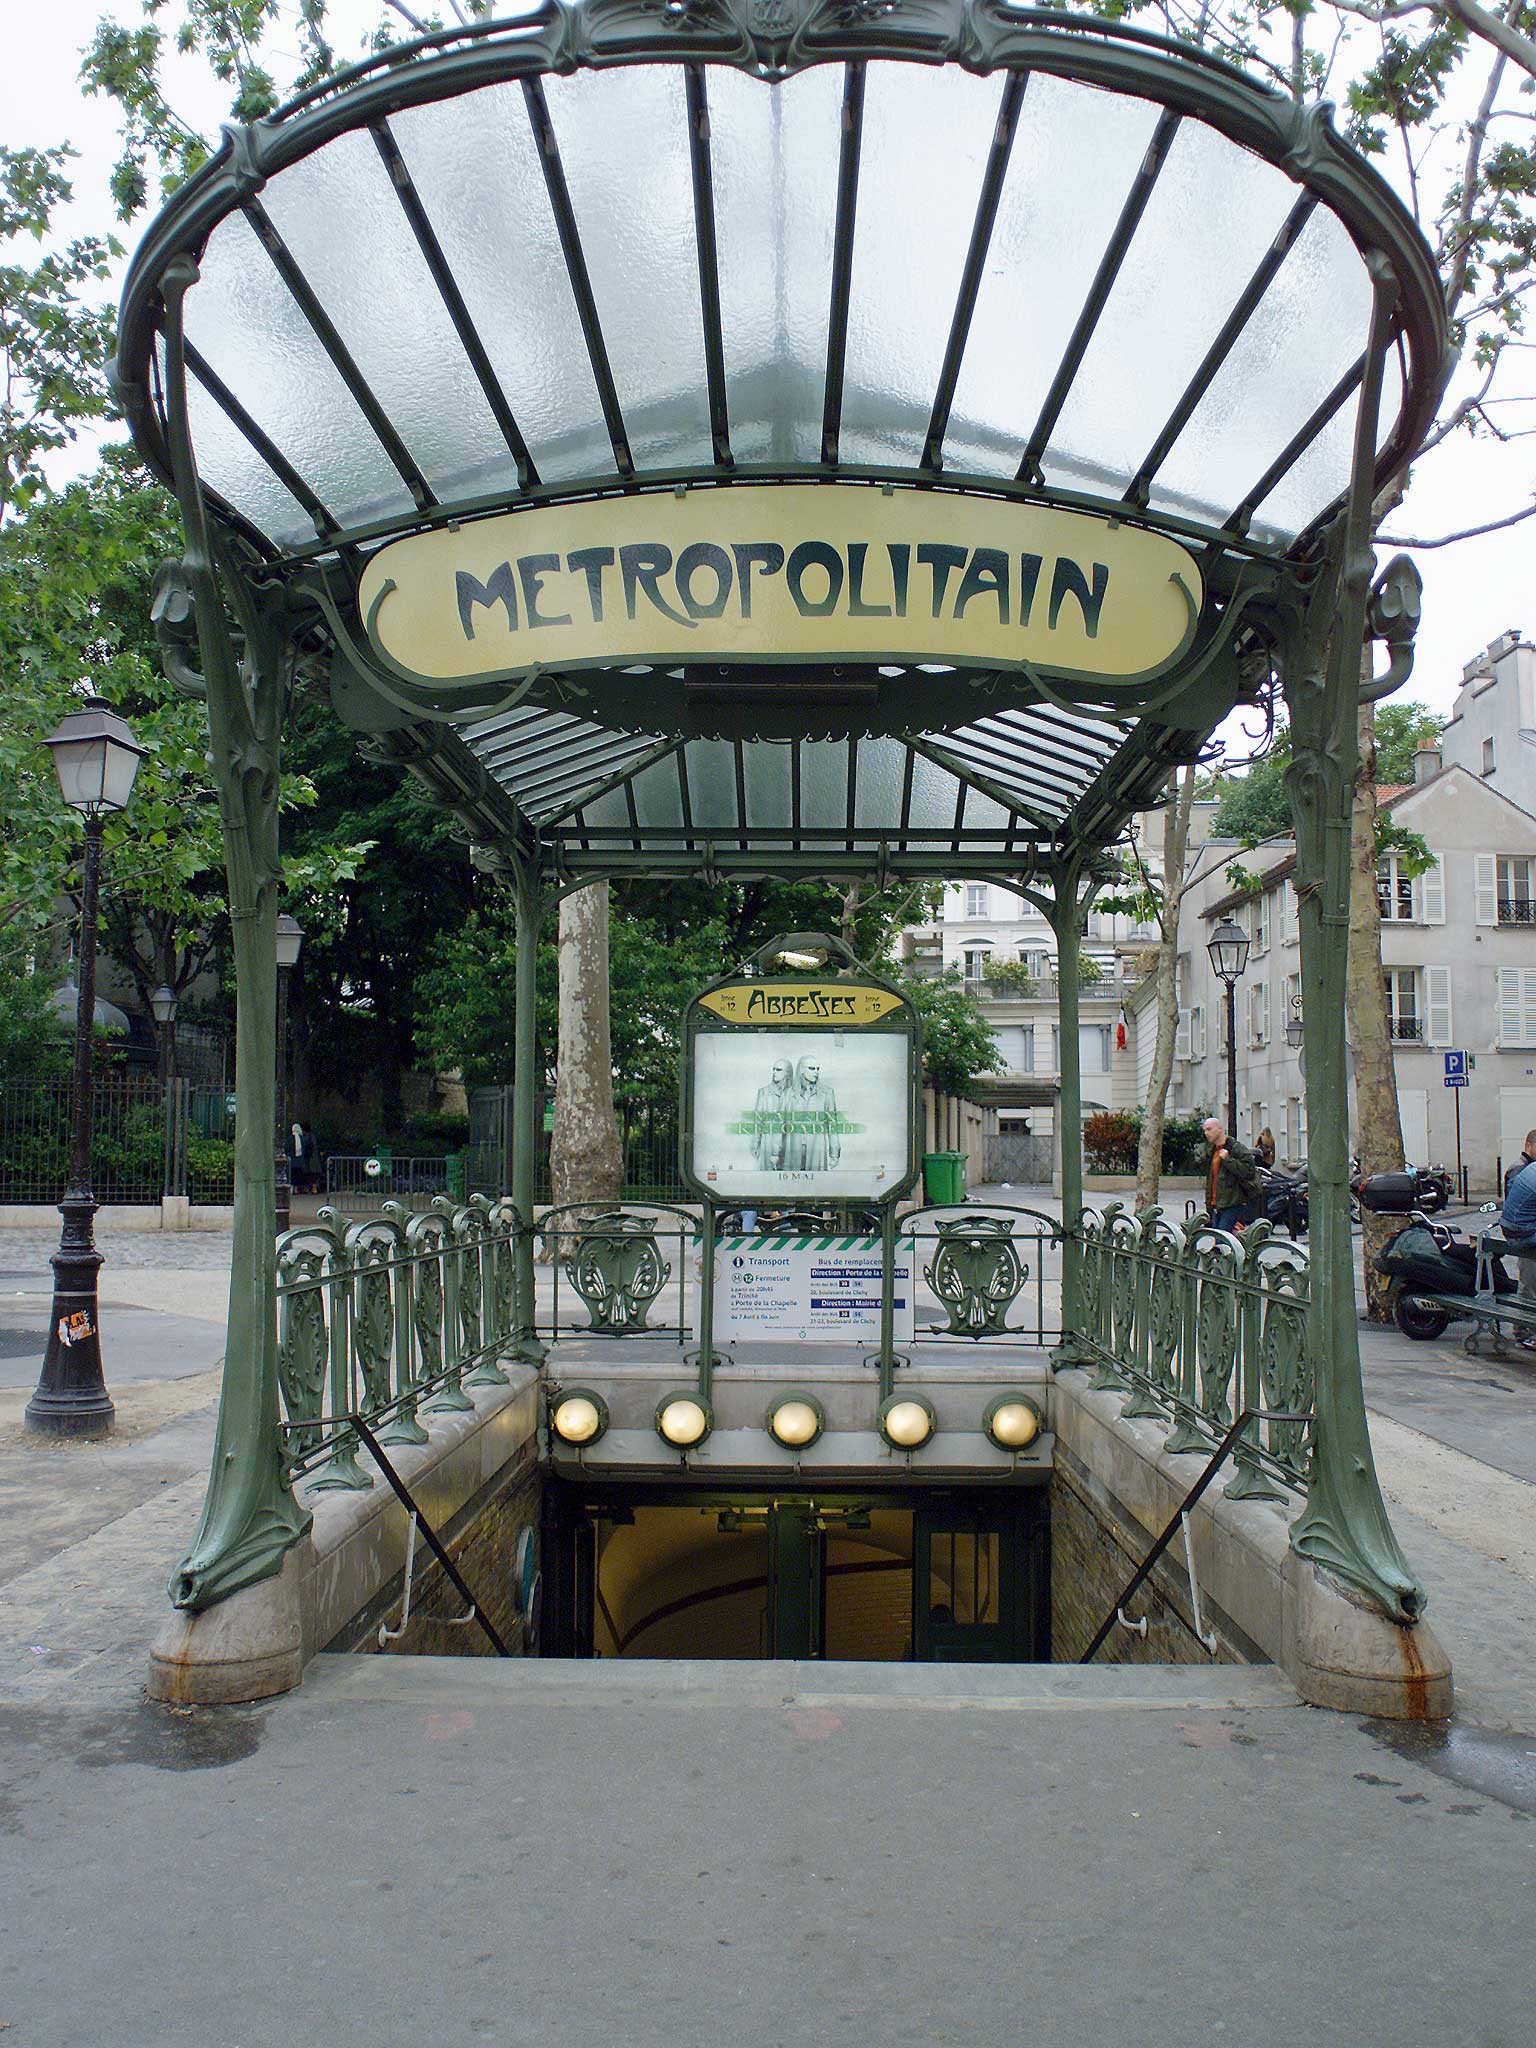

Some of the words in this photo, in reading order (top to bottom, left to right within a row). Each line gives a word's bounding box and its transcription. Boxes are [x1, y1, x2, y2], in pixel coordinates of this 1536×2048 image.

[455, 540, 1110, 640] METROPOLITAIN
[727, 1002, 736, 1012] 12
[747, 989, 856, 1019] ABBESSES
[872, 1003, 881, 1012] 12
[1449, 1055, 1459, 1071] P
[748, 1258, 790, 1267] Transport
